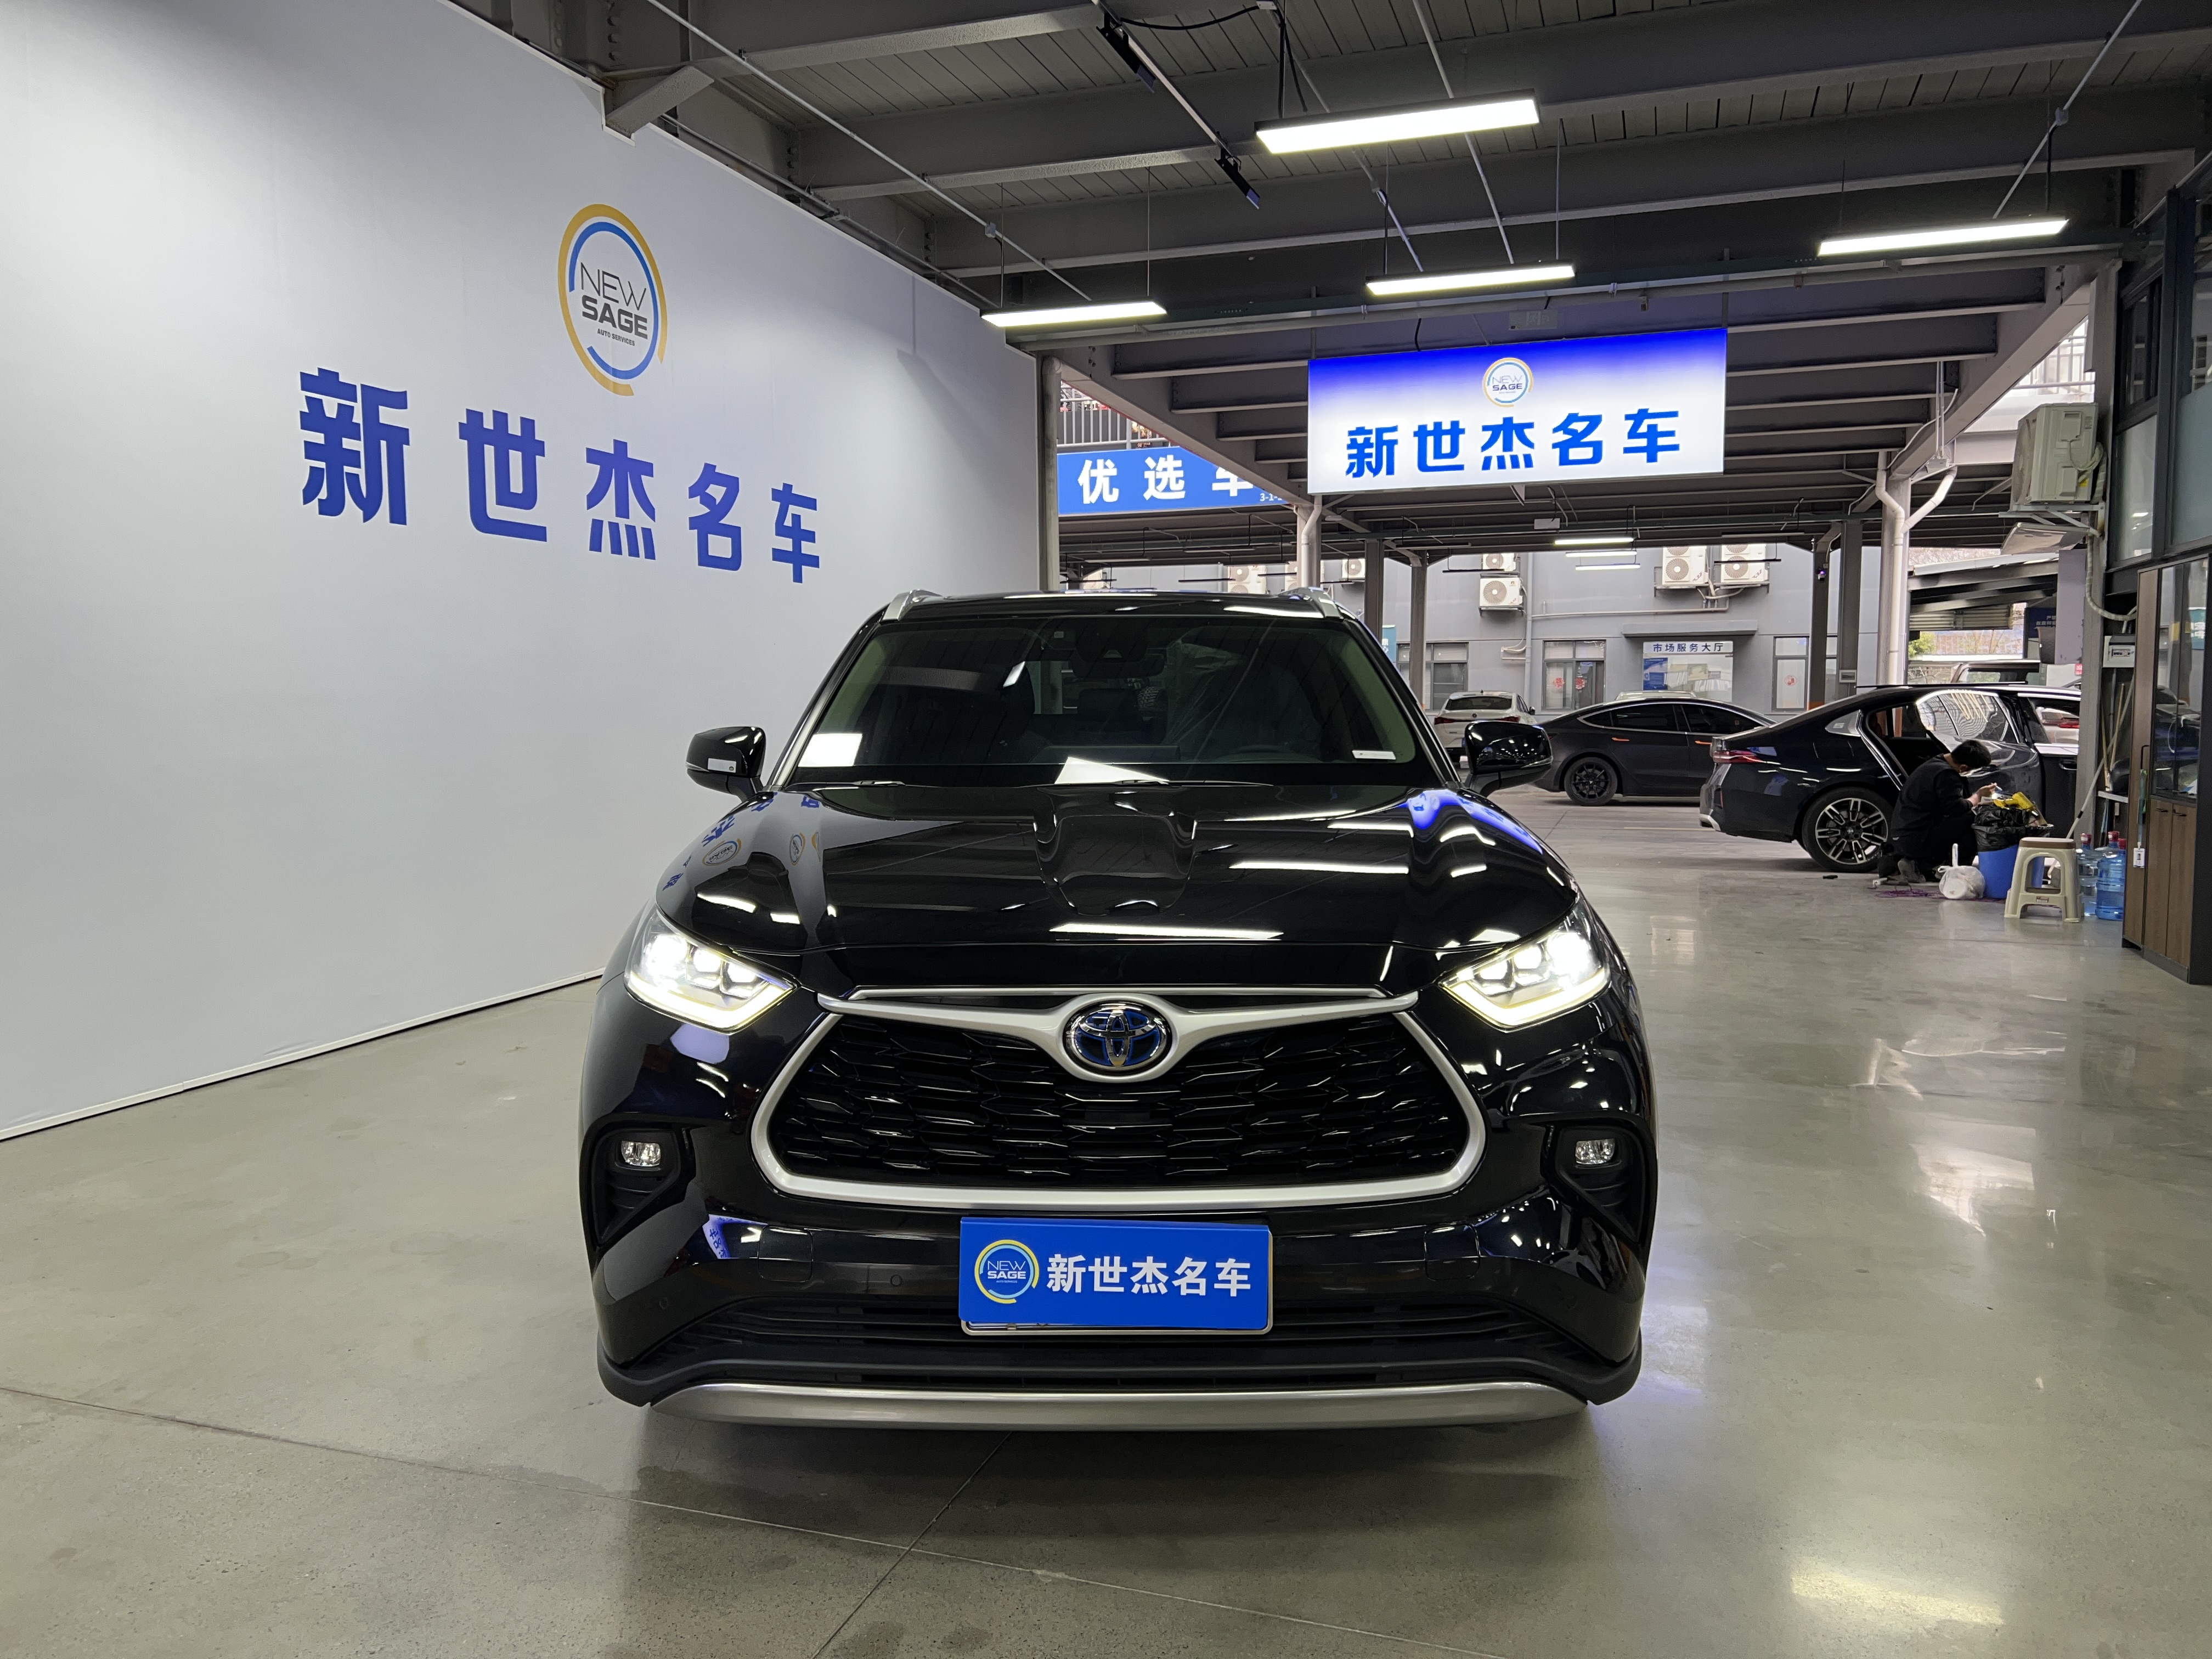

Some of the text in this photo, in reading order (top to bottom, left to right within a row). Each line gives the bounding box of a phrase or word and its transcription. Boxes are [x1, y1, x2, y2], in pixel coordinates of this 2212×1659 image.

[580, 262, 646, 311] NEW
[582, 295, 648, 340] SAGE
[597, 328, 635, 346] AUTO SERVICES
[1492, 375, 1523, 384] NEW
[1345, 408, 1680, 478] 新世杰名车
[299, 367, 820, 584] 新世杰名车
[1260, 493, 1283, 502] 3-1-
[1653, 642, 1724, 653] 市场服务大厅
[988, 1260, 1026, 1271] NEW
[988, 1271, 1026, 1279] SAGE
[1046, 1254, 1251, 1297] 新世杰名车
